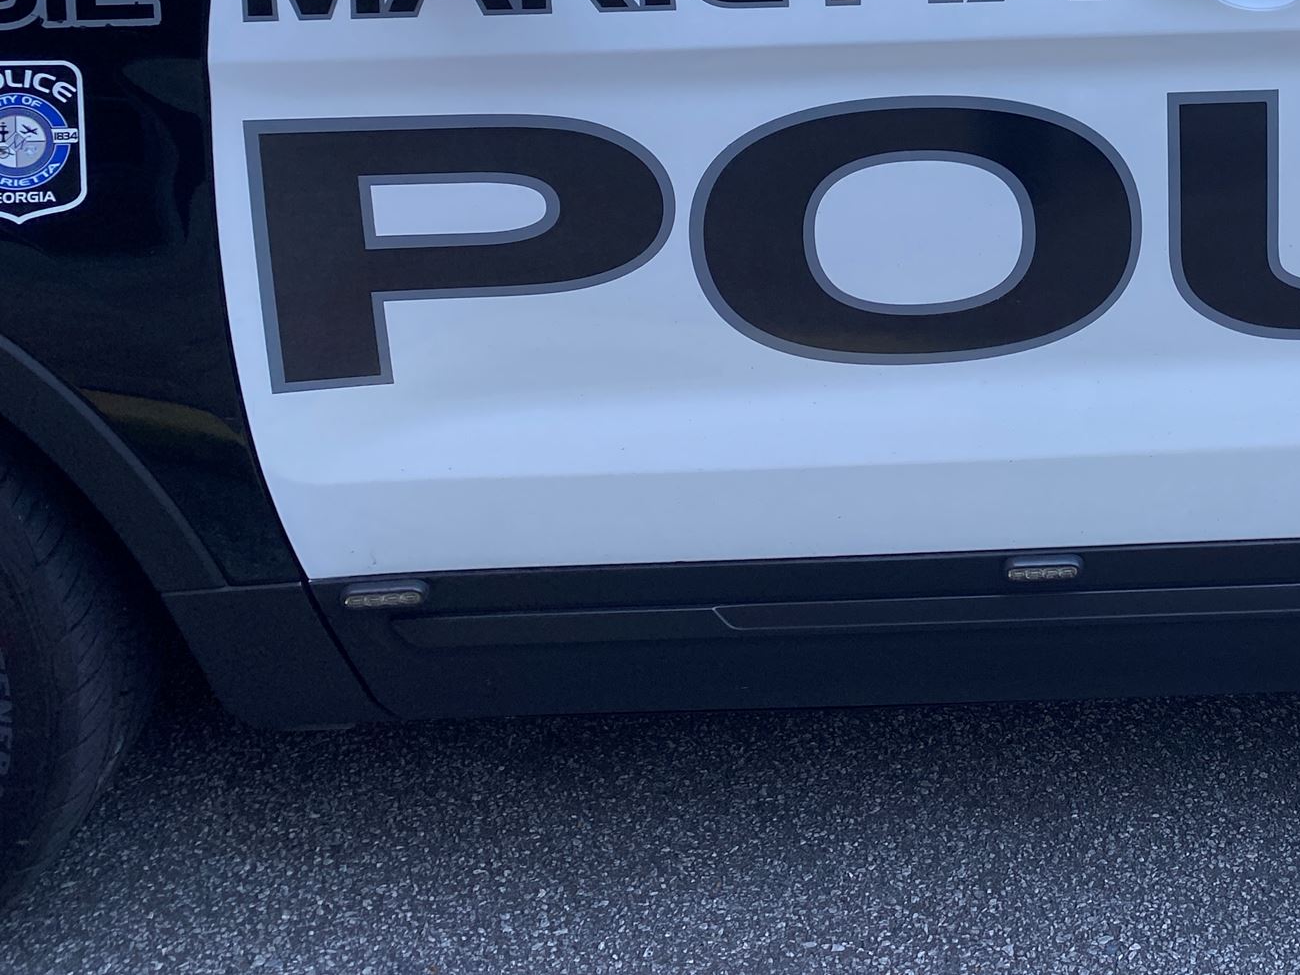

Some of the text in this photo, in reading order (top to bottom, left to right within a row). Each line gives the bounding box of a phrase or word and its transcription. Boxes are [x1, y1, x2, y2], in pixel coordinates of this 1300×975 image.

[0, 69, 77, 104] LICE
[0, 95, 42, 107] TY OF
[54, 131, 77, 141] 1834
